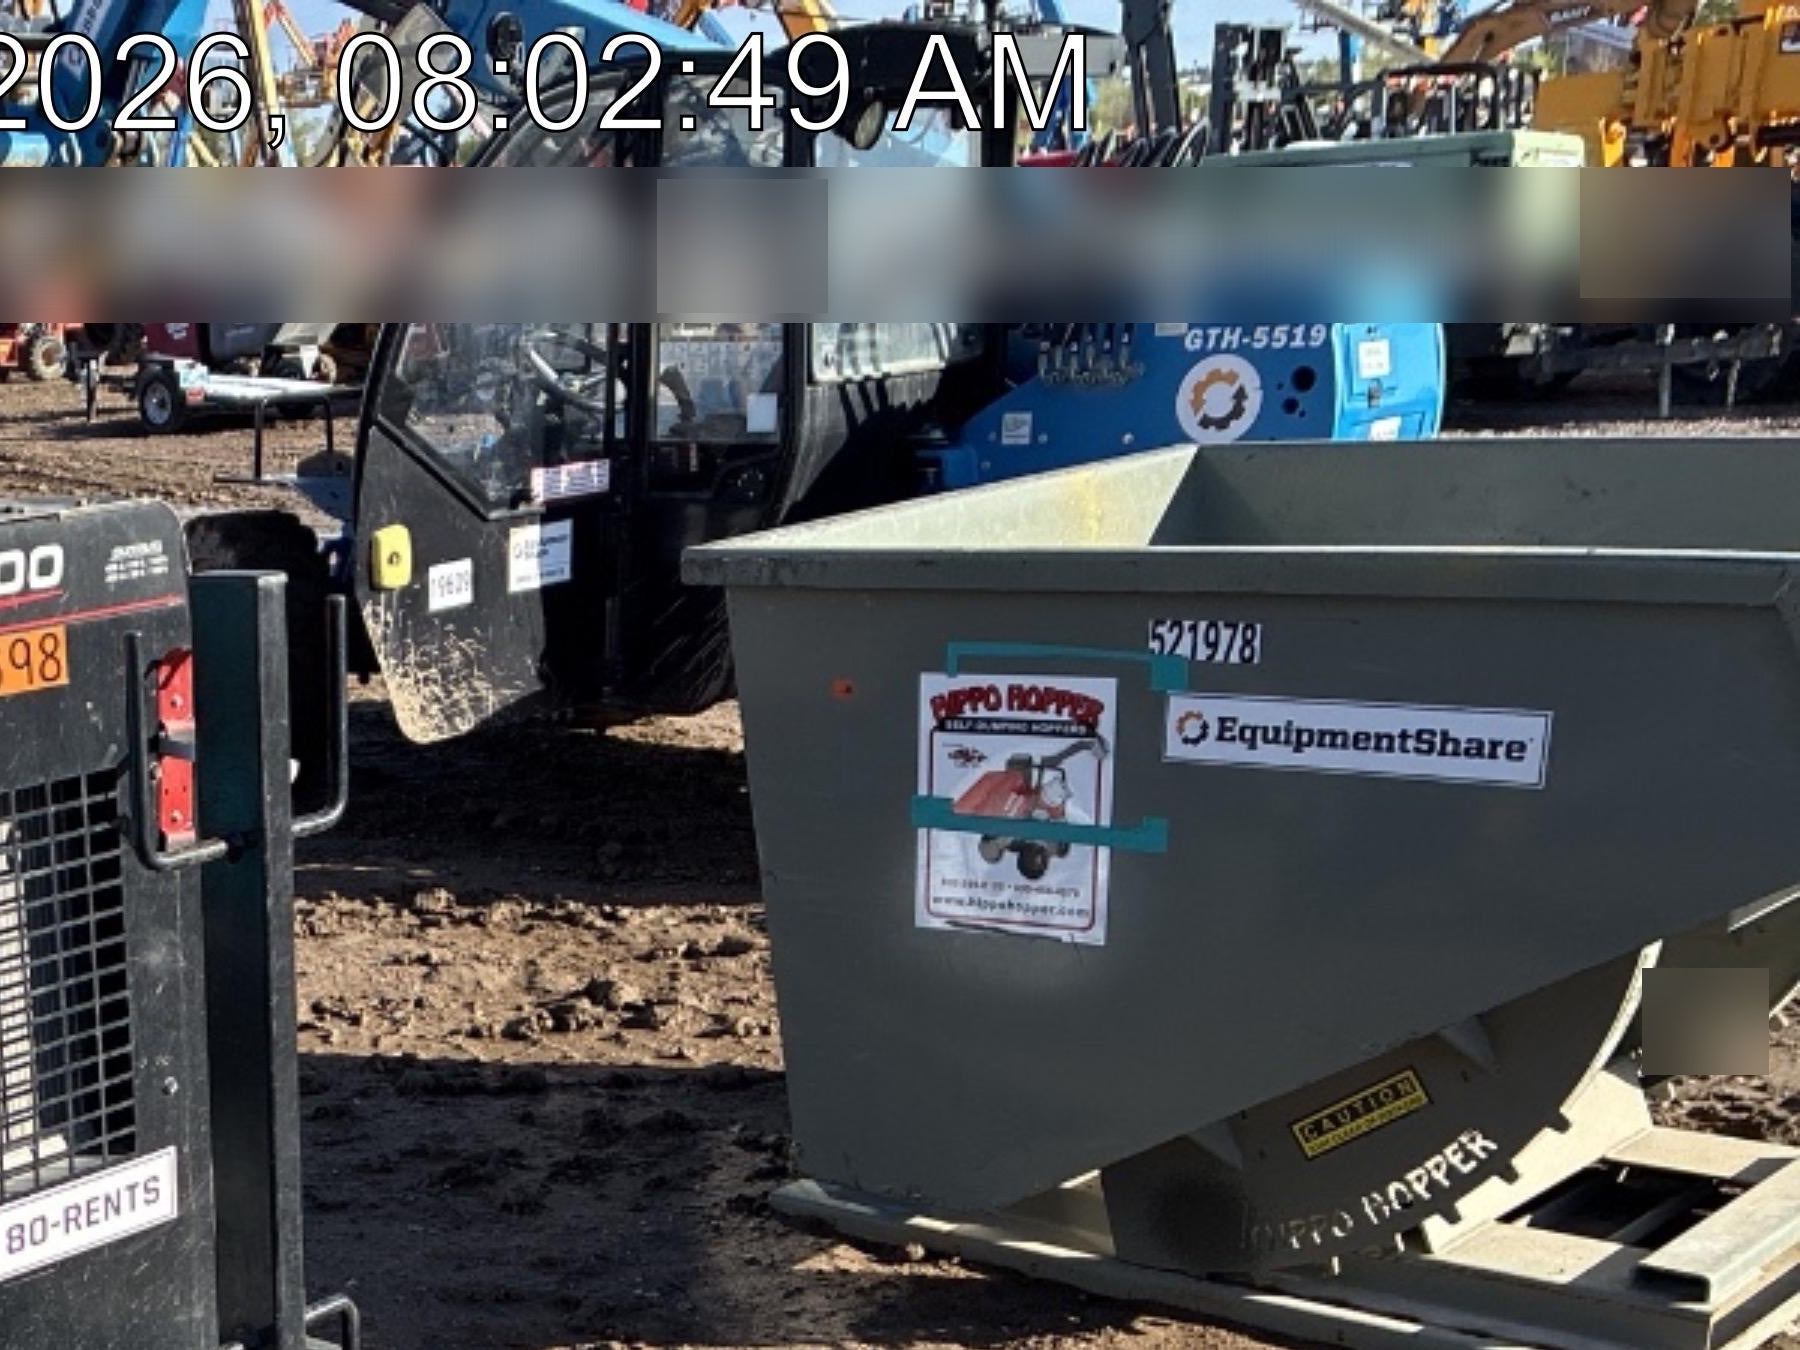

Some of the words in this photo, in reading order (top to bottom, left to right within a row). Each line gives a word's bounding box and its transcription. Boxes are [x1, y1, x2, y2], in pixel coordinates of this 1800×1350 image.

[1184, 323, 1327, 351] GTH-5519
[1149, 619, 1257, 664] 521978
[1214, 715, 1527, 763] EquipmentShare
[1302, 1077, 1417, 1143] CAUTION
[1360, 1127, 1499, 1226] HOPPER
[6, 1175, 162, 1257] 80-RENTS
